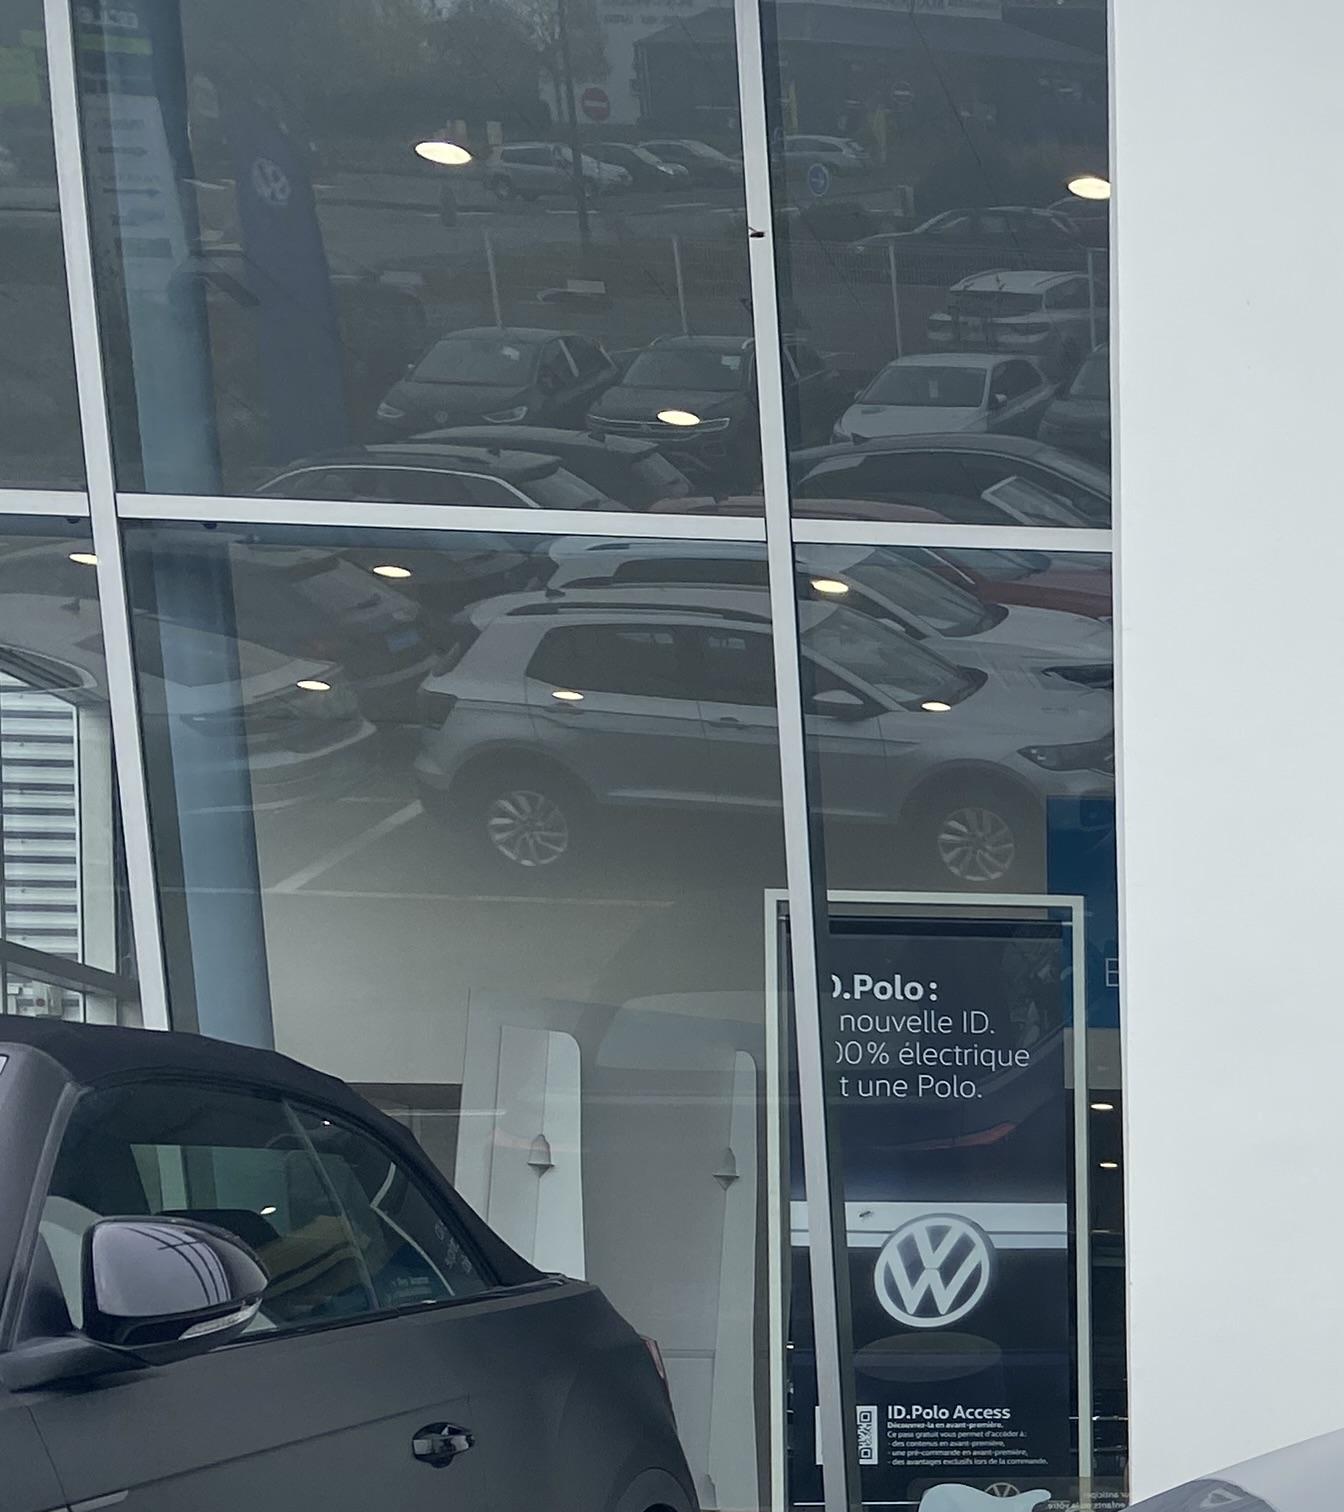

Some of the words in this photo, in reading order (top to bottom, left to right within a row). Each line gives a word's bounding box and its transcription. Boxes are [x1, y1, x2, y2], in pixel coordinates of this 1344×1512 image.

[840, 1009, 953, 1034] nouvelle
[963, 1010, 996, 1034] ID.
[899, 1041, 1030, 1072] électrique
[858, 1079, 908, 1098] une
[918, 1074, 982, 1098] Polo.
[887, 1404, 950, 1420] ID.Polo
[952, 1404, 1011, 1420] Access
